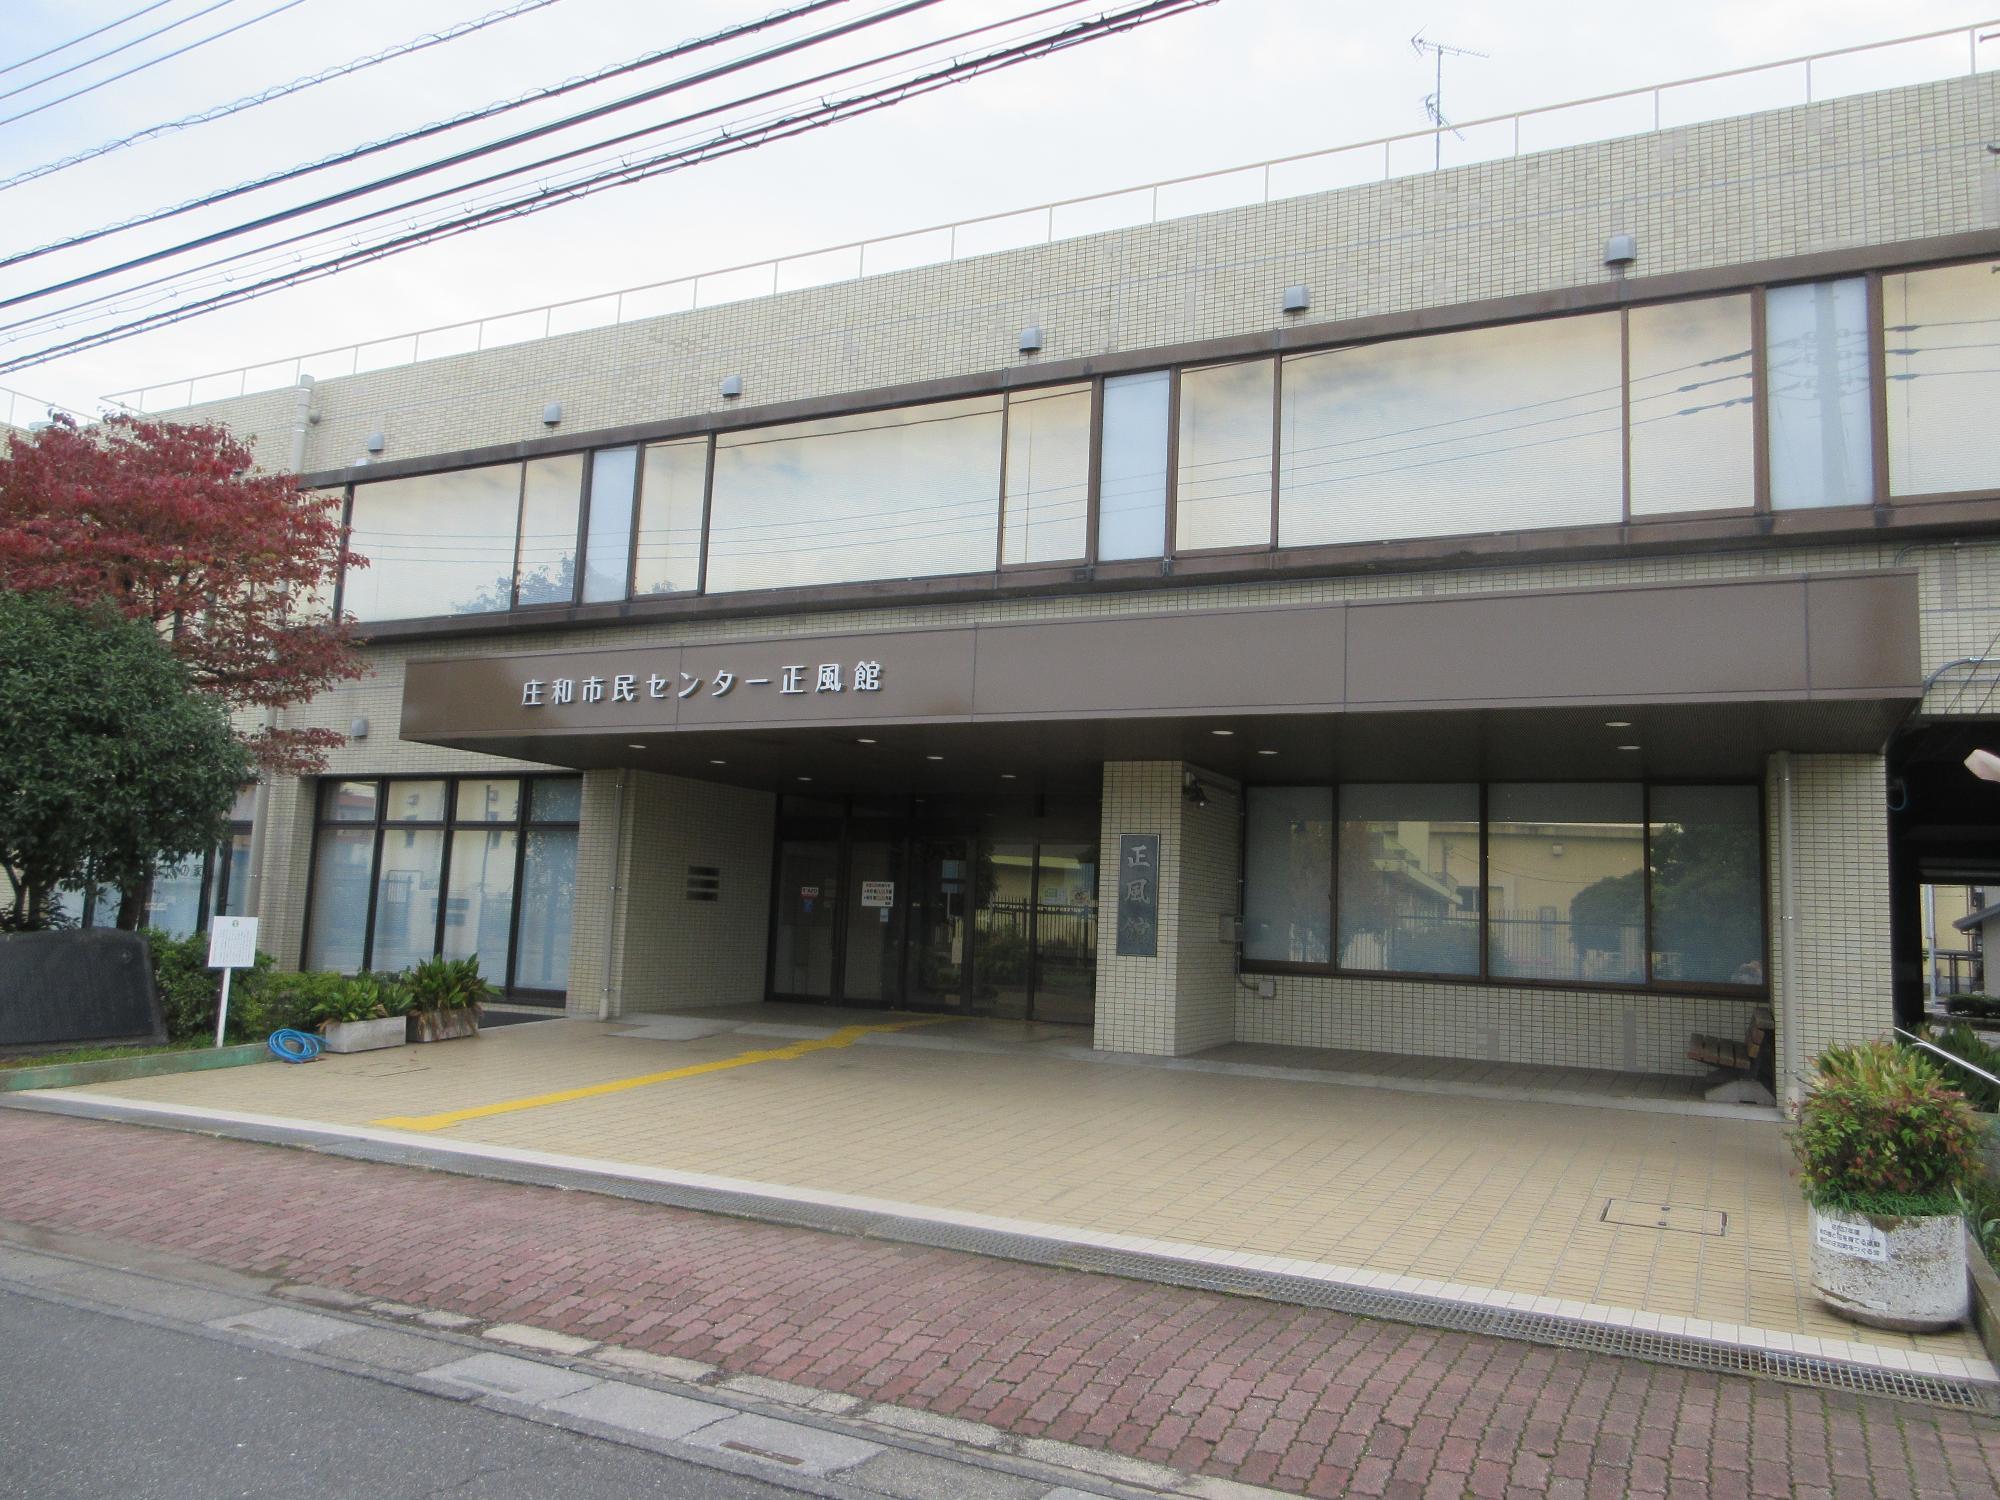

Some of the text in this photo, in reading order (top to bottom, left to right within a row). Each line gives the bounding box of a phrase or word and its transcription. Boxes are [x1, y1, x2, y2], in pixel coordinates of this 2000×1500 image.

[521, 660, 881, 706] 庄和市民センター正風館
